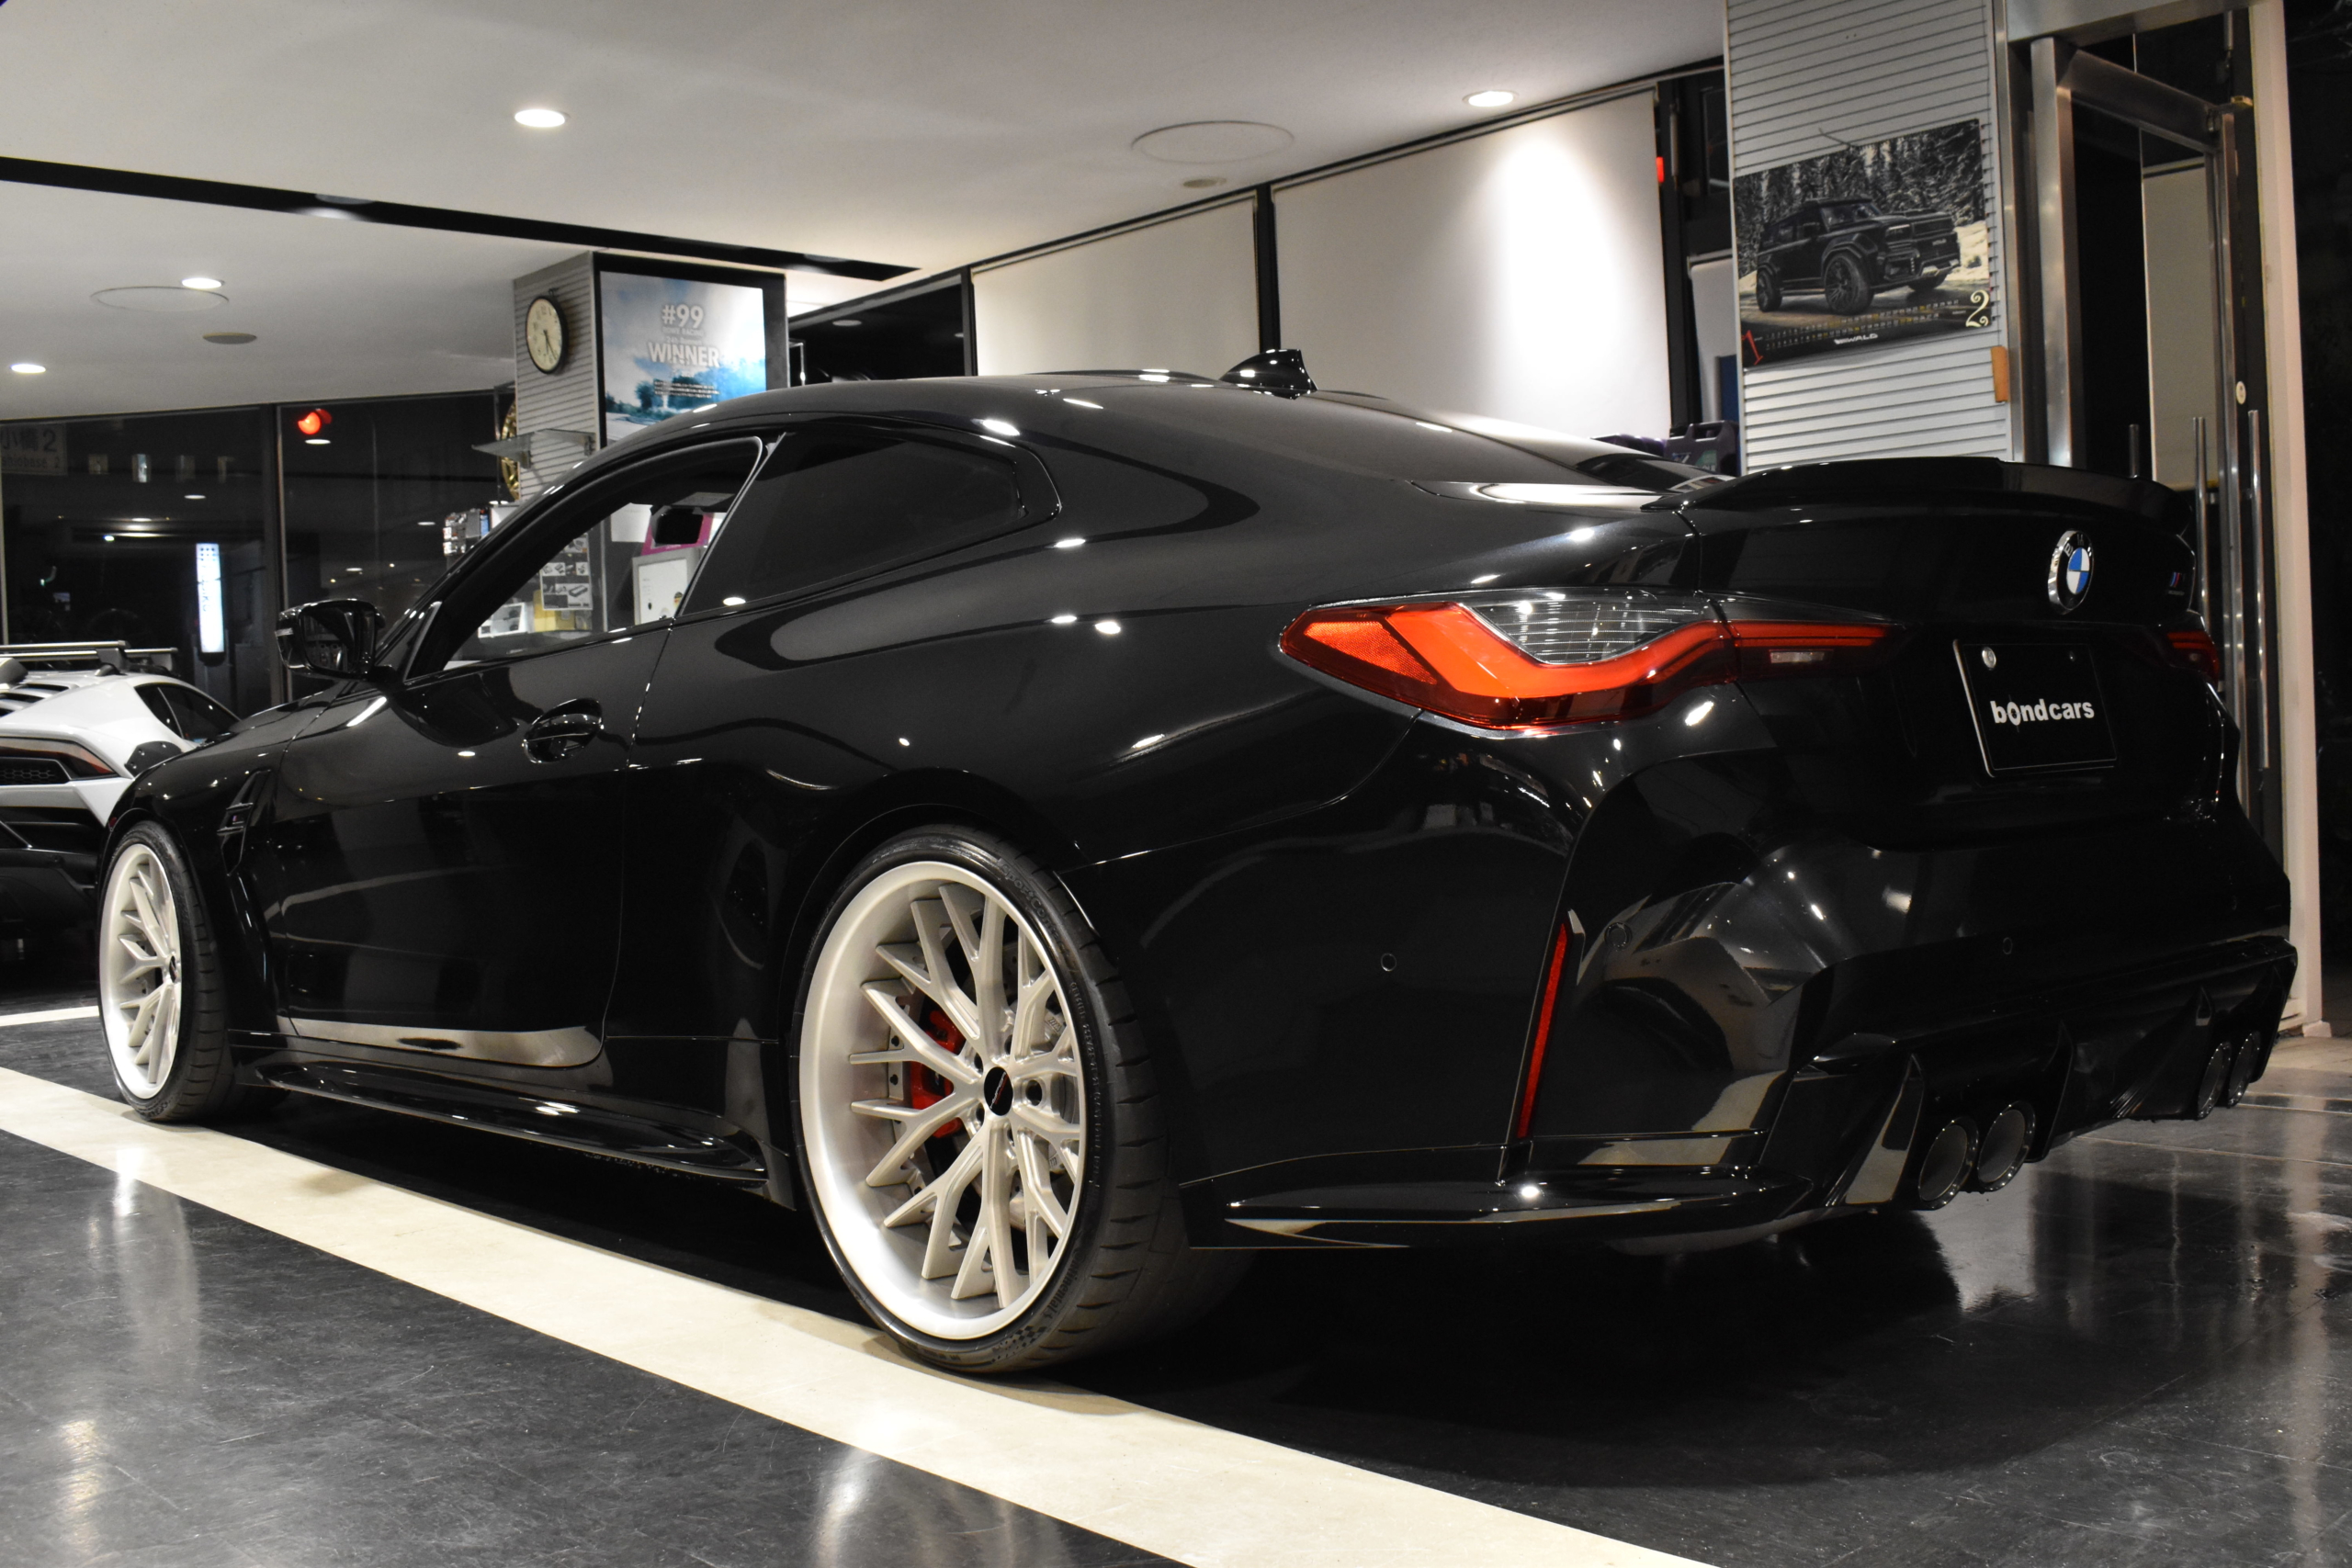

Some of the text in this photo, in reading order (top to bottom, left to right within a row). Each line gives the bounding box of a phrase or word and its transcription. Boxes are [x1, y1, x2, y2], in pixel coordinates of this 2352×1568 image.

[662, 303, 704, 329] #99
[1964, 289, 1990, 328] 2
[1848, 333, 1879, 344] WALD
[647, 341, 720, 368] WINNER
